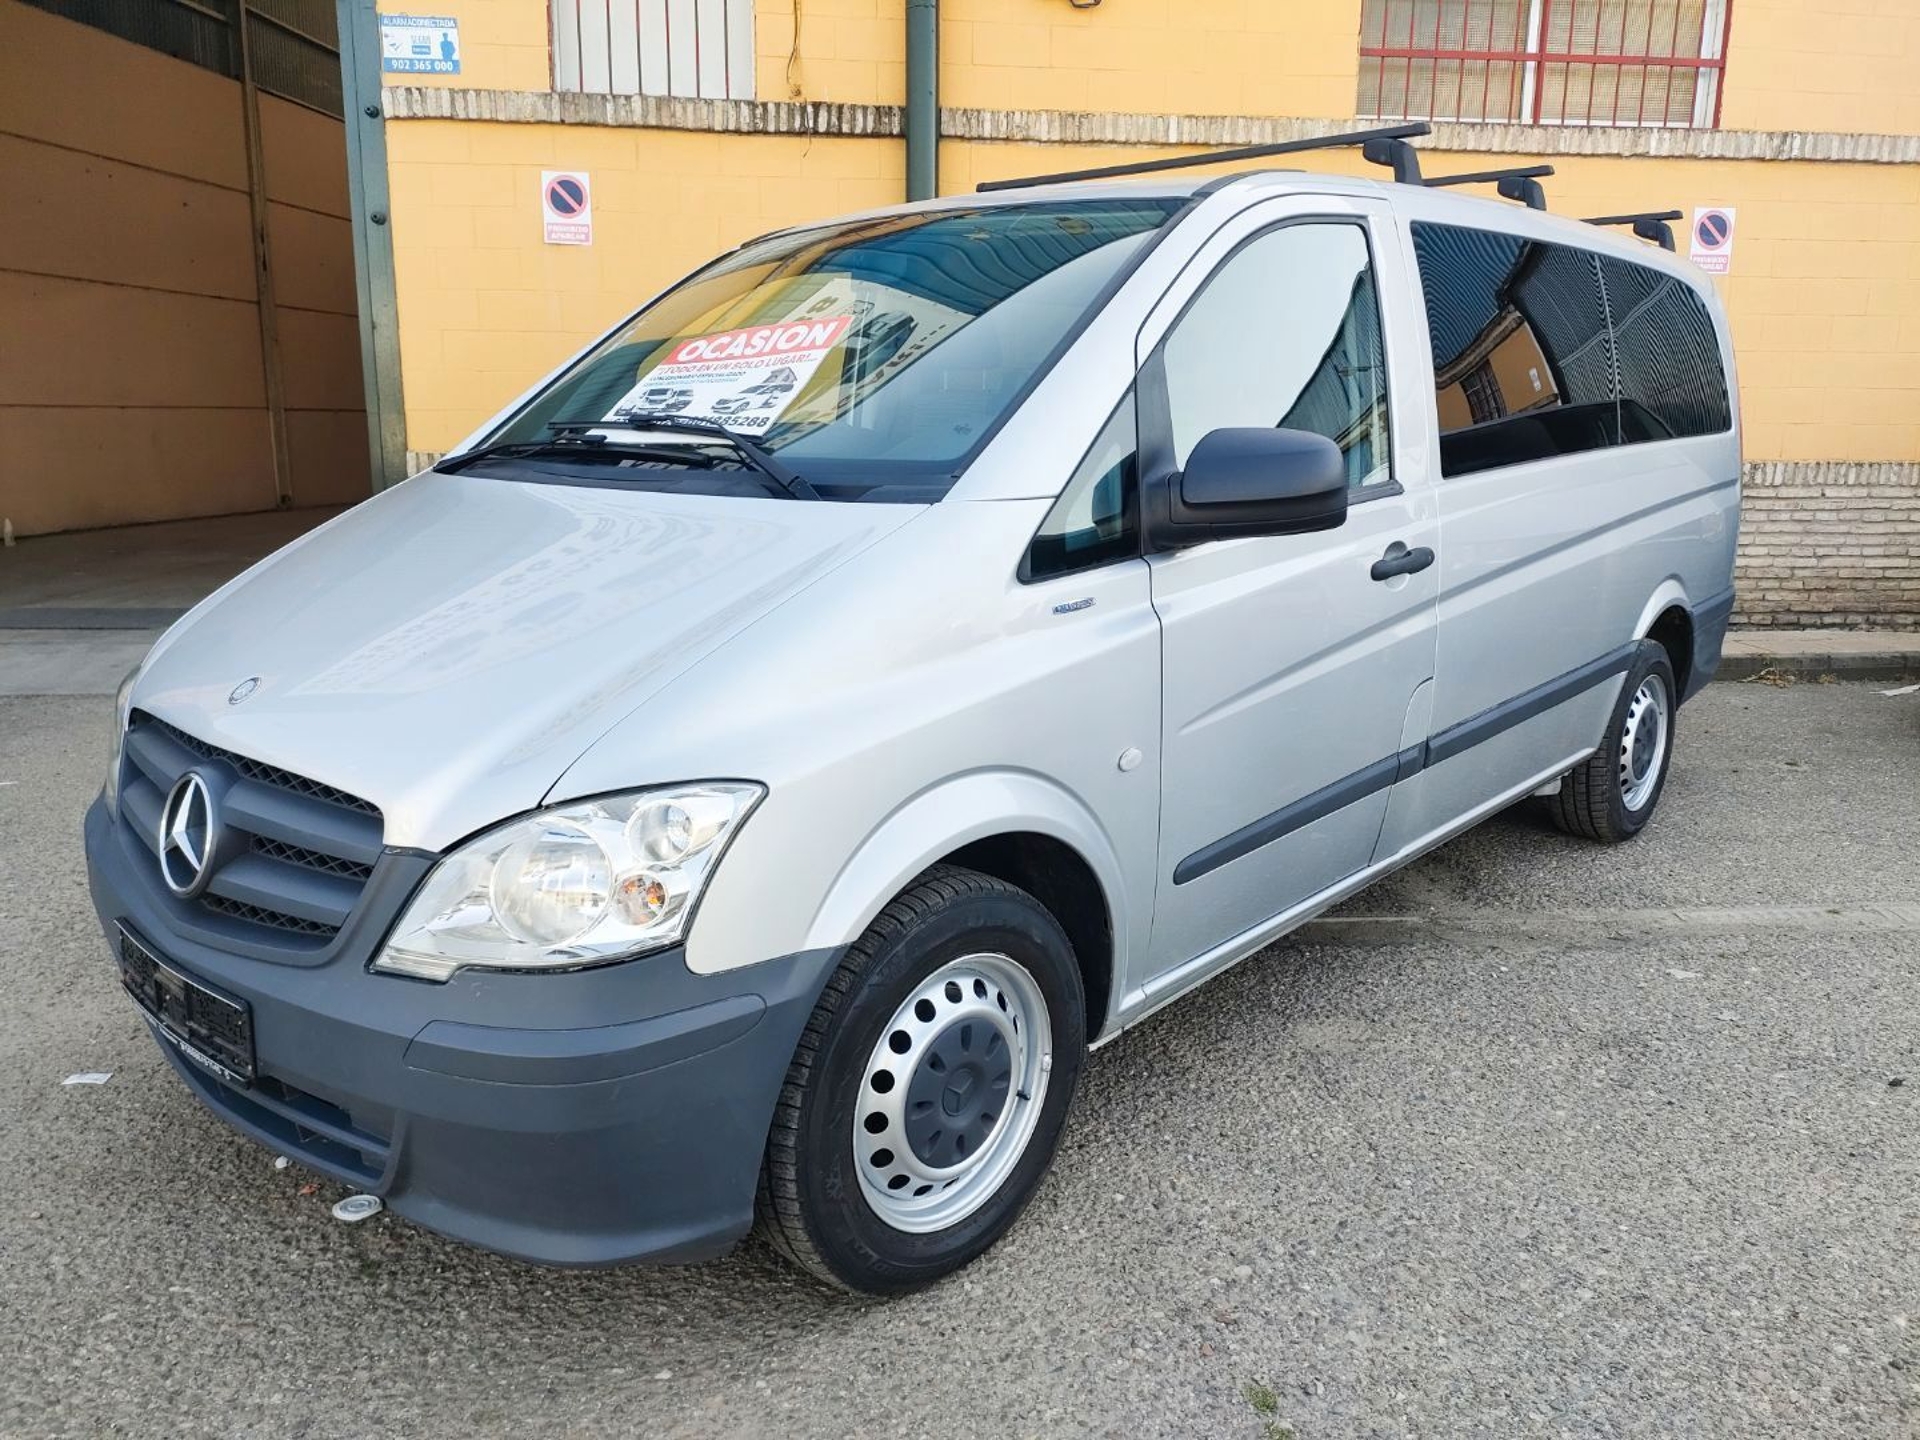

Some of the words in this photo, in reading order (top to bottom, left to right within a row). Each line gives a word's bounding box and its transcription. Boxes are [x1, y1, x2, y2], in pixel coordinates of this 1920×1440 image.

[391, 59, 410, 69] 902
[413, 60, 432, 70] 365
[434, 61, 454, 71] 000
[676, 321, 838, 362] OCASION
[697, 363, 712, 372] EN
[713, 362, 731, 371] UN
[731, 359, 765, 370] SOLO
